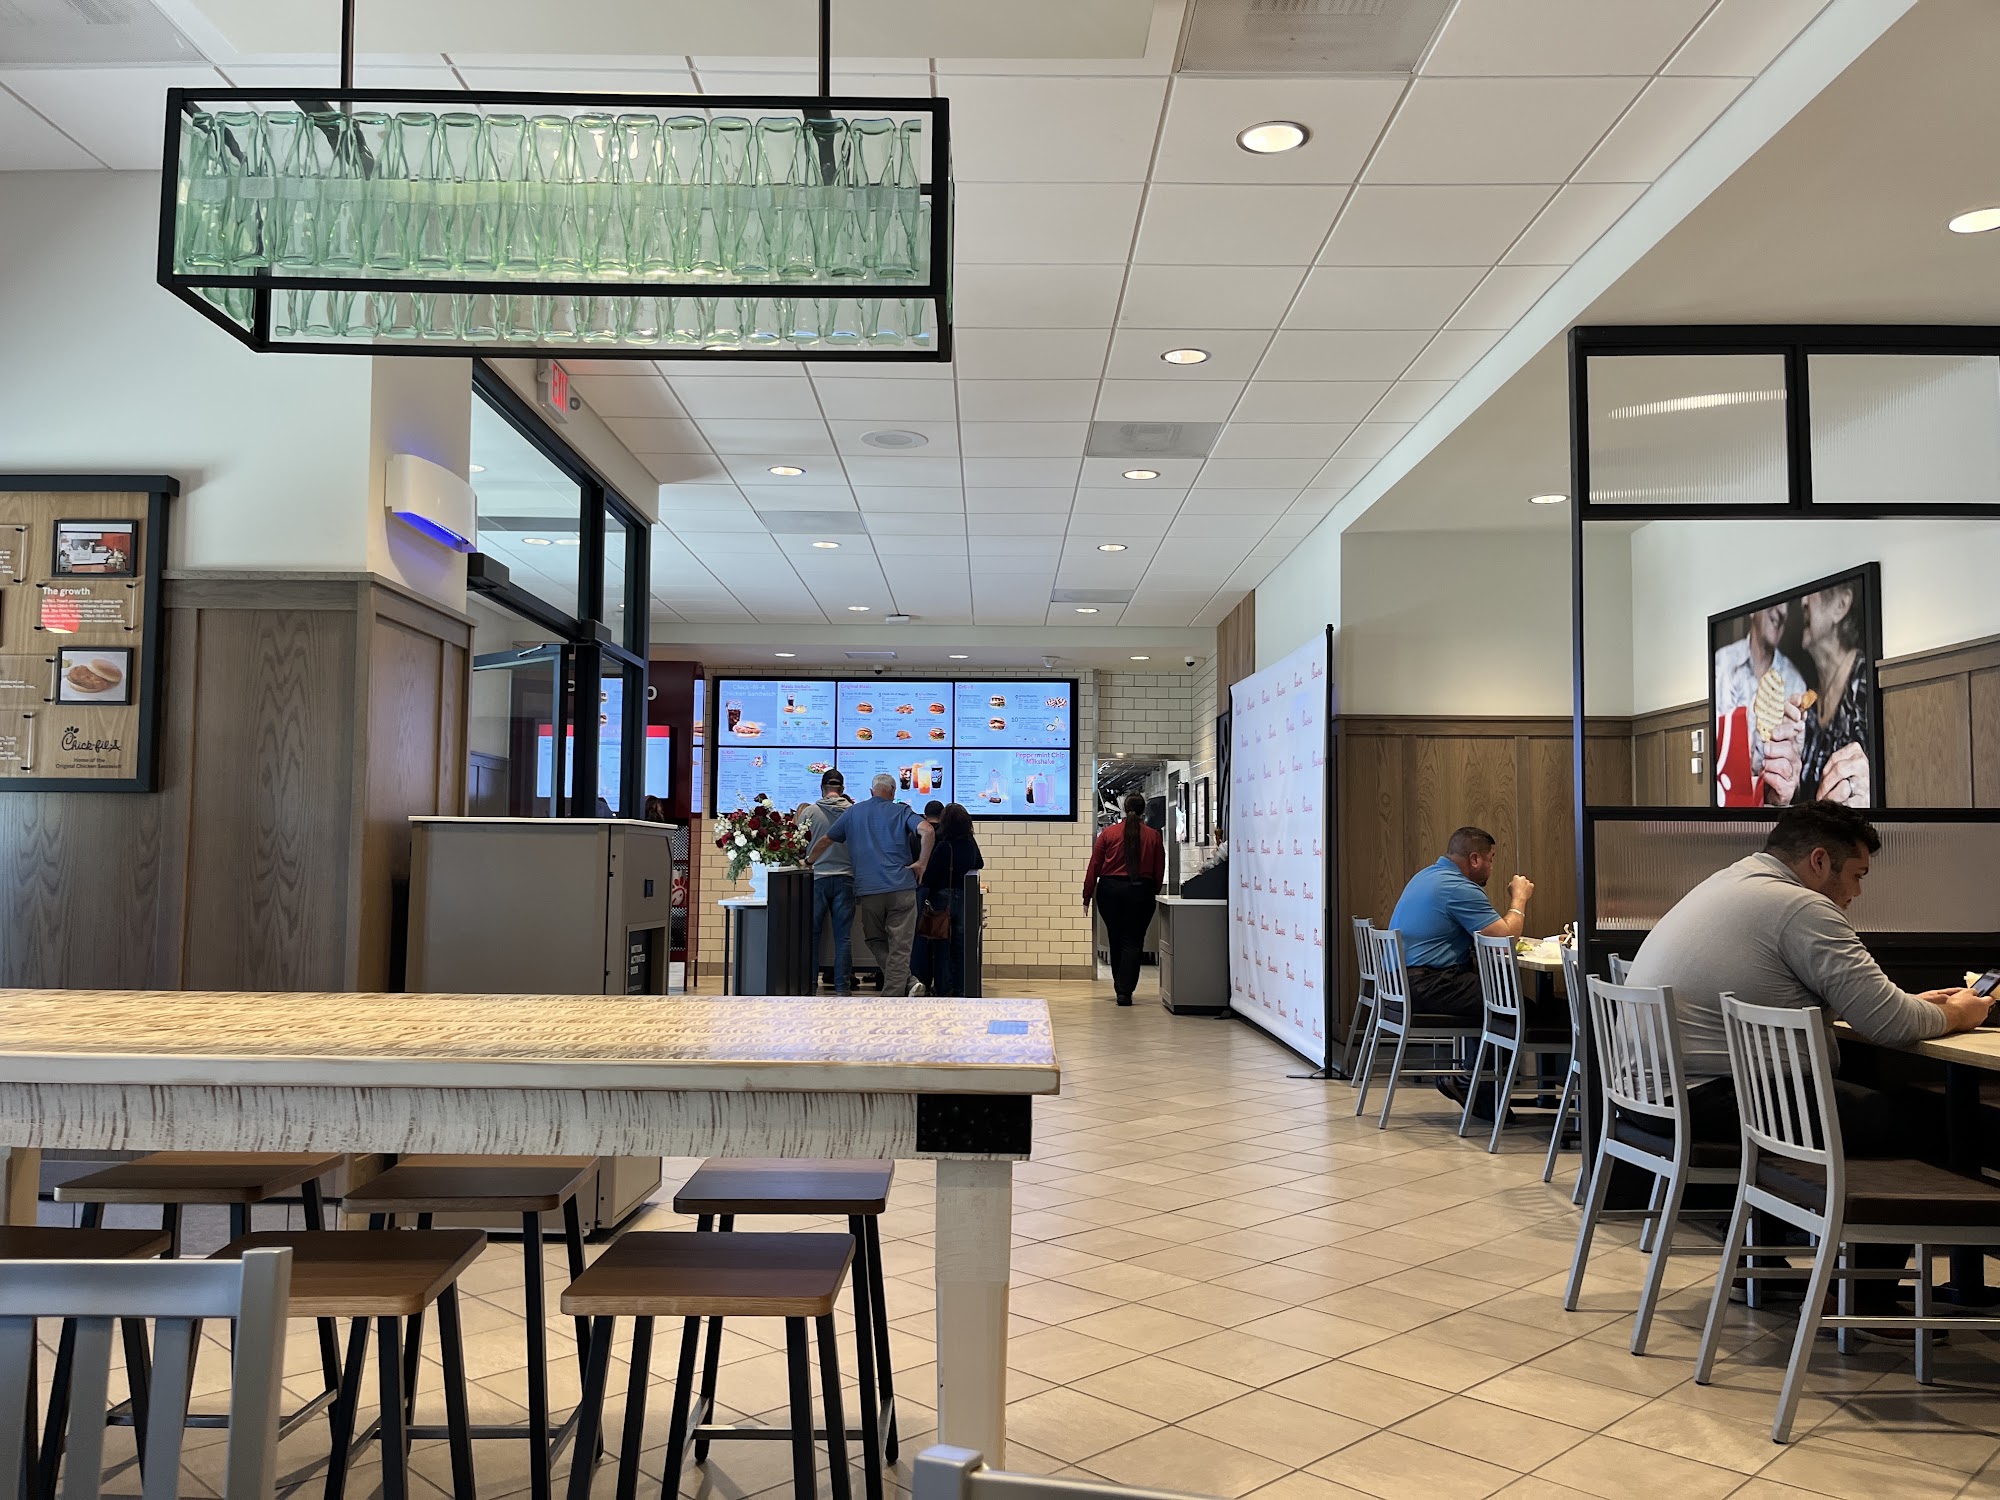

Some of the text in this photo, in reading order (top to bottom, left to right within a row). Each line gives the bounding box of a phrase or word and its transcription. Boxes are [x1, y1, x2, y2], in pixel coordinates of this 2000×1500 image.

[42, 586, 91, 596] The growth
[723, 690, 747, 698] Chicken
[747, 690, 776, 698] Sandwich
[61, 726, 121, 753] Chick-fil-A
